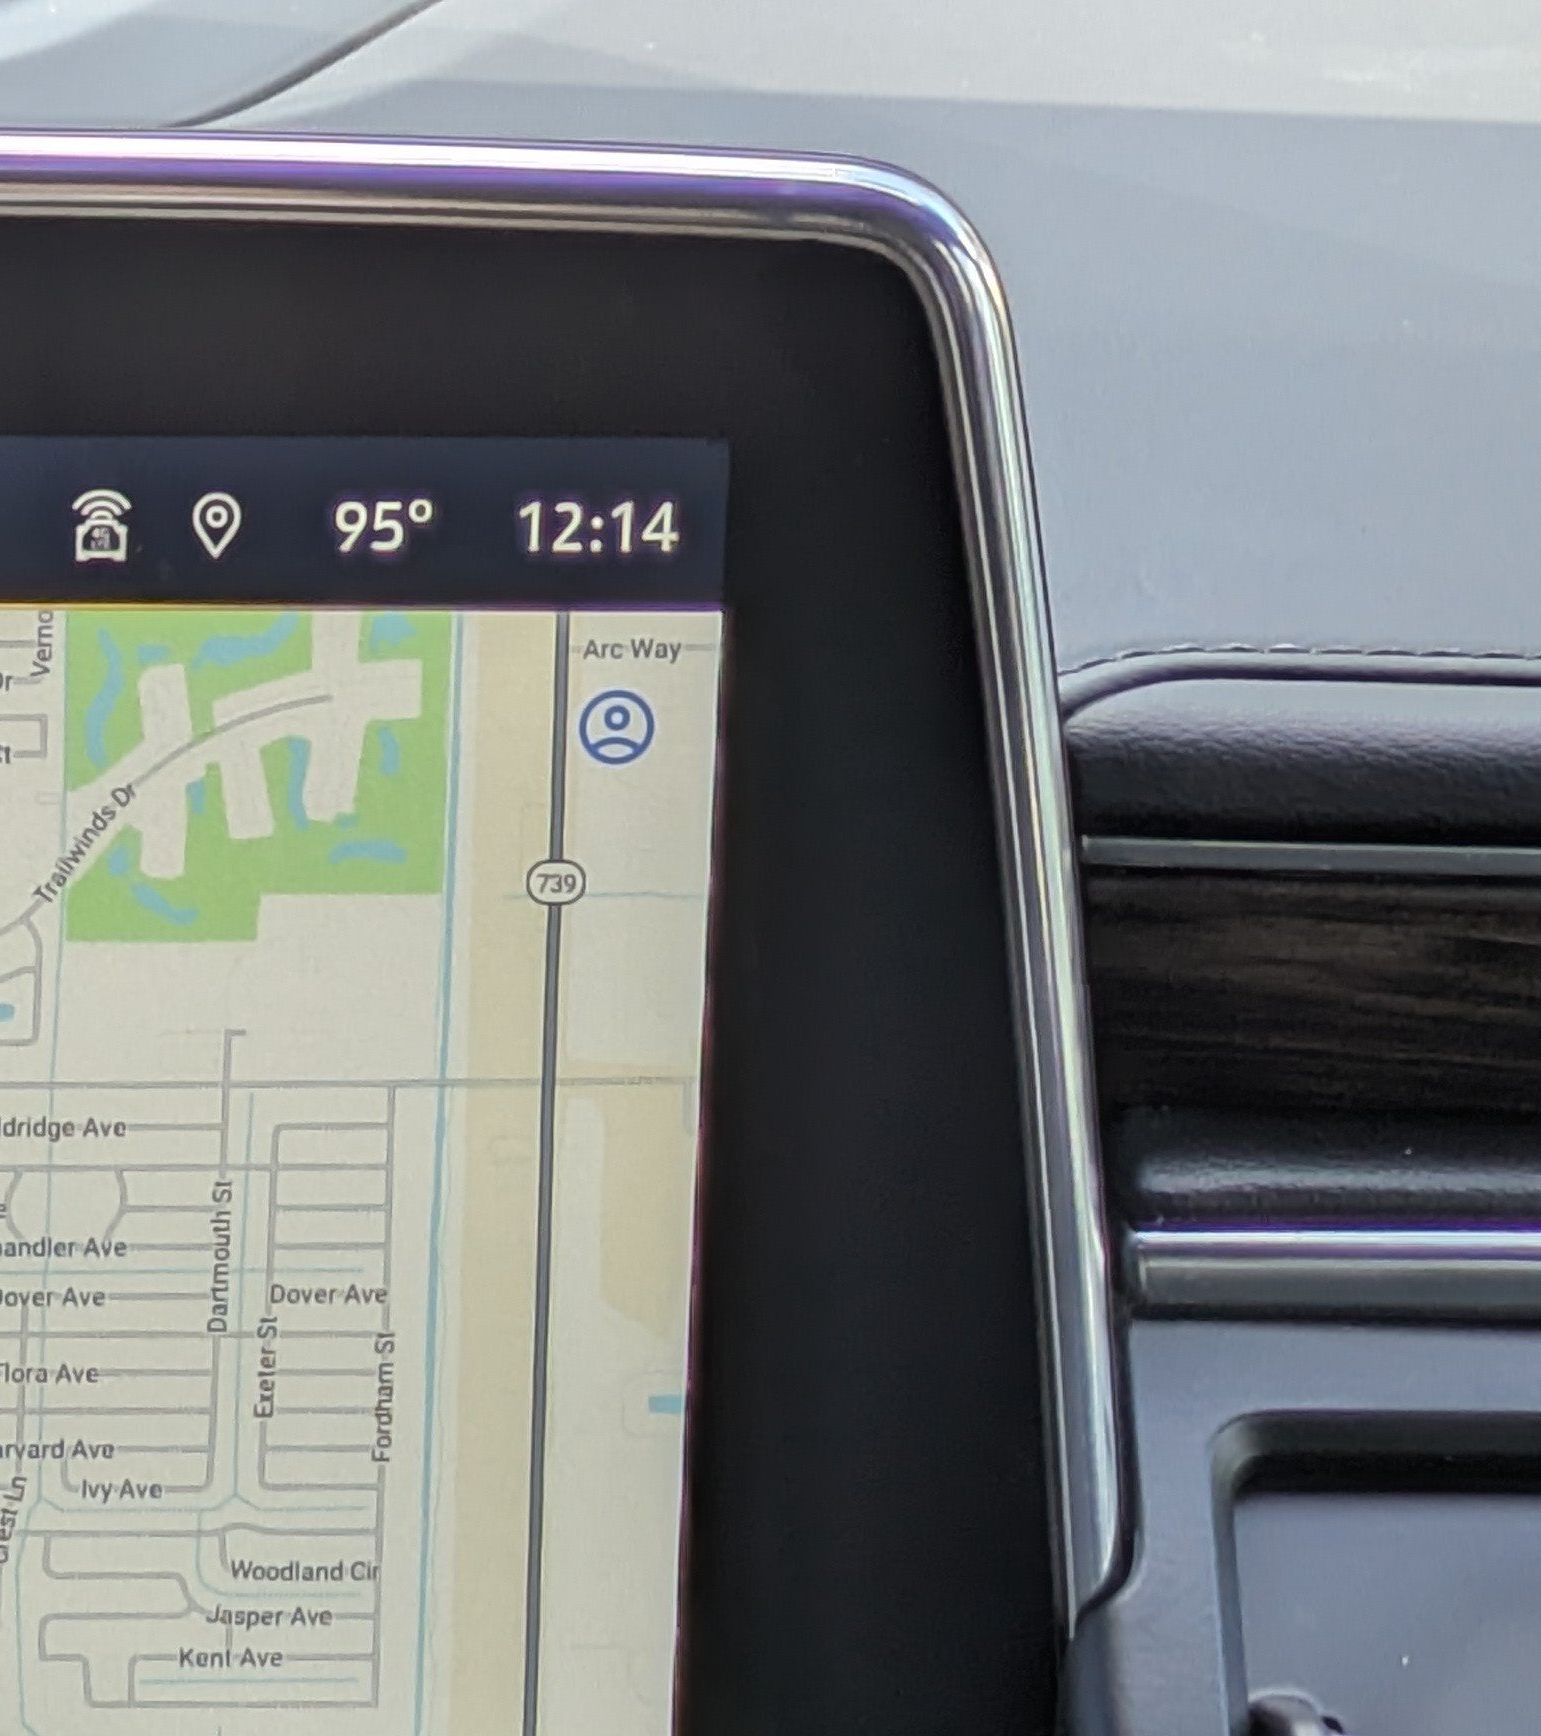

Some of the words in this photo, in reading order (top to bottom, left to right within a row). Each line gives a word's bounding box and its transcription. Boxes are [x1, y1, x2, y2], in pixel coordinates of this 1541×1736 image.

[334, 499, 434, 553] 95°
[518, 499, 680, 554] 12:14
[582, 638, 623, 660] Arc
[628, 637, 682, 664] Way
[32, 808, 116, 904] Trailwinds
[111, 783, 137, 807] Dr
[536, 873, 576, 894] 739
[83, 1117, 126, 1138] Ave
[210, 1180, 233, 1204] St
[83, 1237, 127, 1258] Ave
[207, 1210, 232, 1334] Dartmouth
[62, 1287, 106, 1307] Ave
[270, 1284, 337, 1305] Dover
[344, 1284, 388, 1305] Ave
[257, 1315, 279, 1338] St
[374, 1332, 396, 1354] St
[55, 1363, 100, 1384] Ave
[371, 1362, 394, 1463] Fordham
[71, 1440, 115, 1460] Ave
[2, 1475, 28, 1503] Ln
[81, 1479, 113, 1501] Ivy
[119, 1479, 163, 1499] Ave
[230, 1560, 344, 1582] Woodland
[350, 1561, 379, 1581] Cir
[206, 1606, 284, 1631] Jasper
[290, 1606, 333, 1627] Ave
[179, 1647, 231, 1669] Kent
[240, 1647, 284, 1668] Ave
